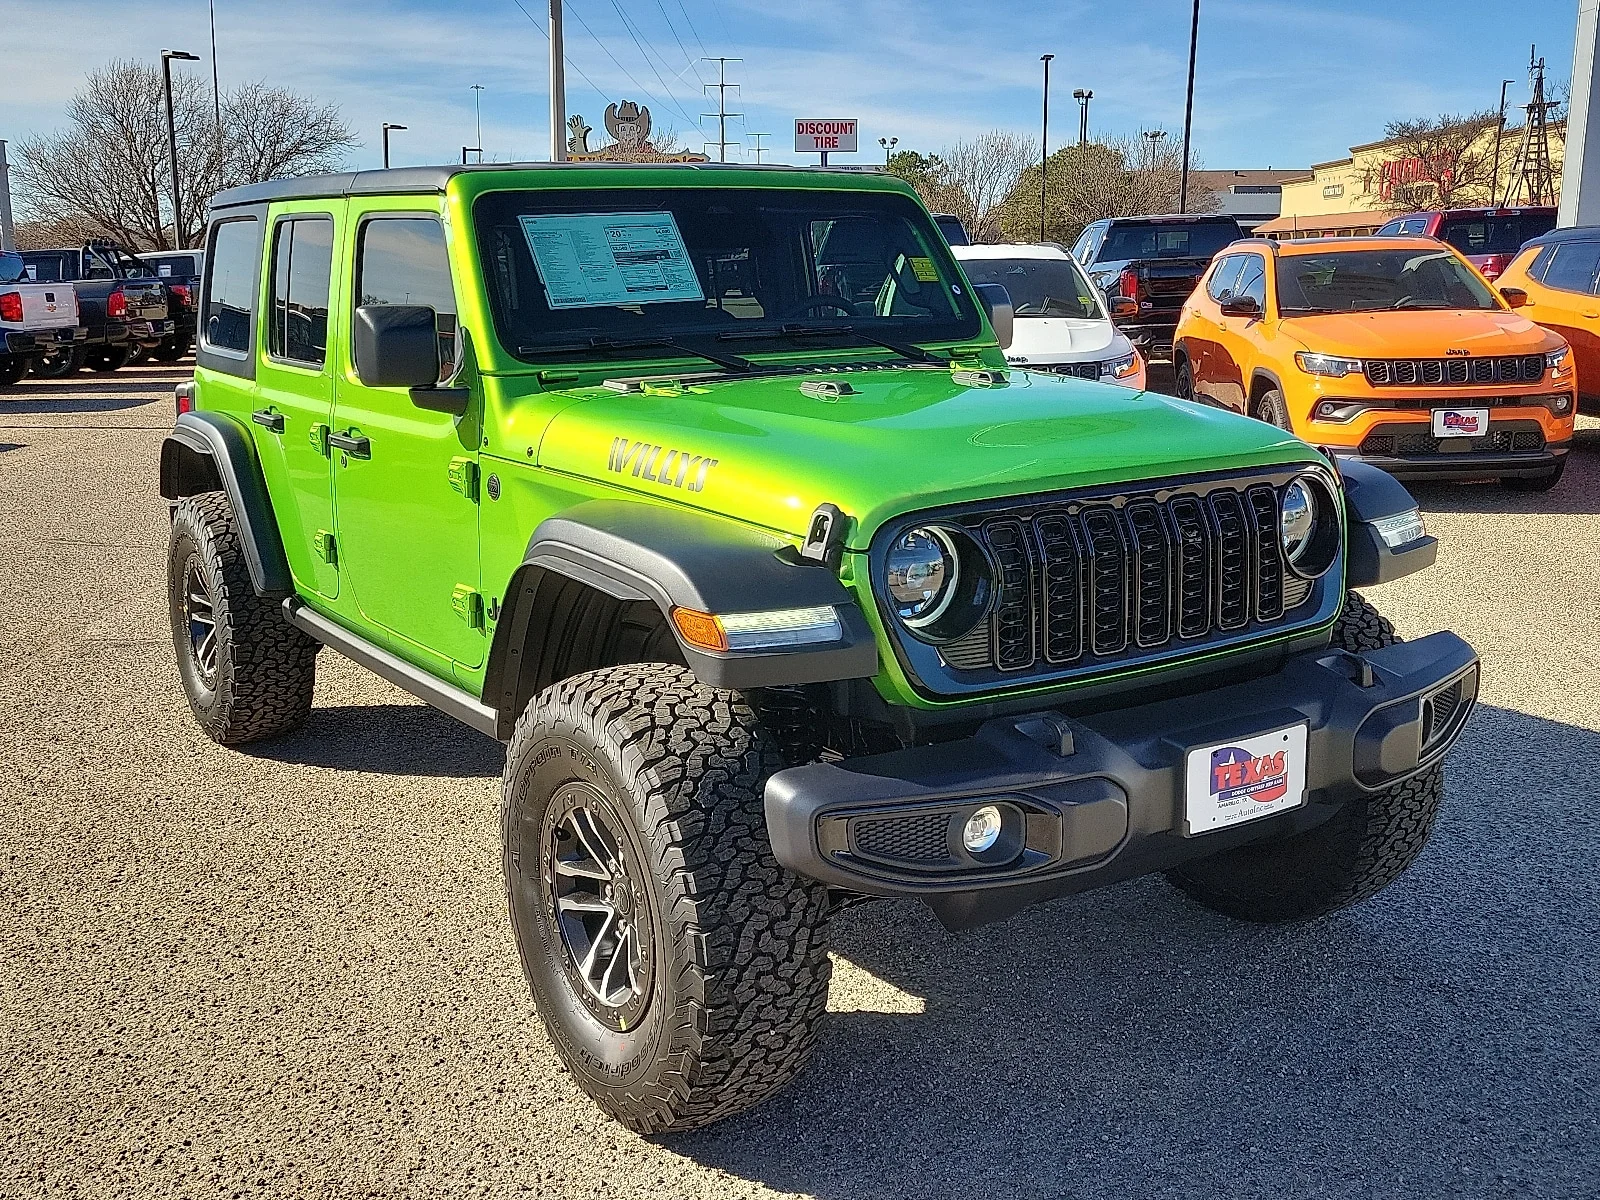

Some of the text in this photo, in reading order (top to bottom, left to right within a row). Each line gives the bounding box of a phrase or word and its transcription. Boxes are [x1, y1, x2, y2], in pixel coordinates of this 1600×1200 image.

[797, 122, 855, 135] DISCOUNT
[813, 136, 839, 149] TIRE
[1445, 348, 1471, 356] Jeep
[1006, 355, 1029, 364] Jeep
[1446, 416, 1478, 426] TEXAS
[608, 436, 719, 493] WILLYS
[1214, 750, 1285, 790] TEXAS
[1231, 787, 1247, 797] DODGE
